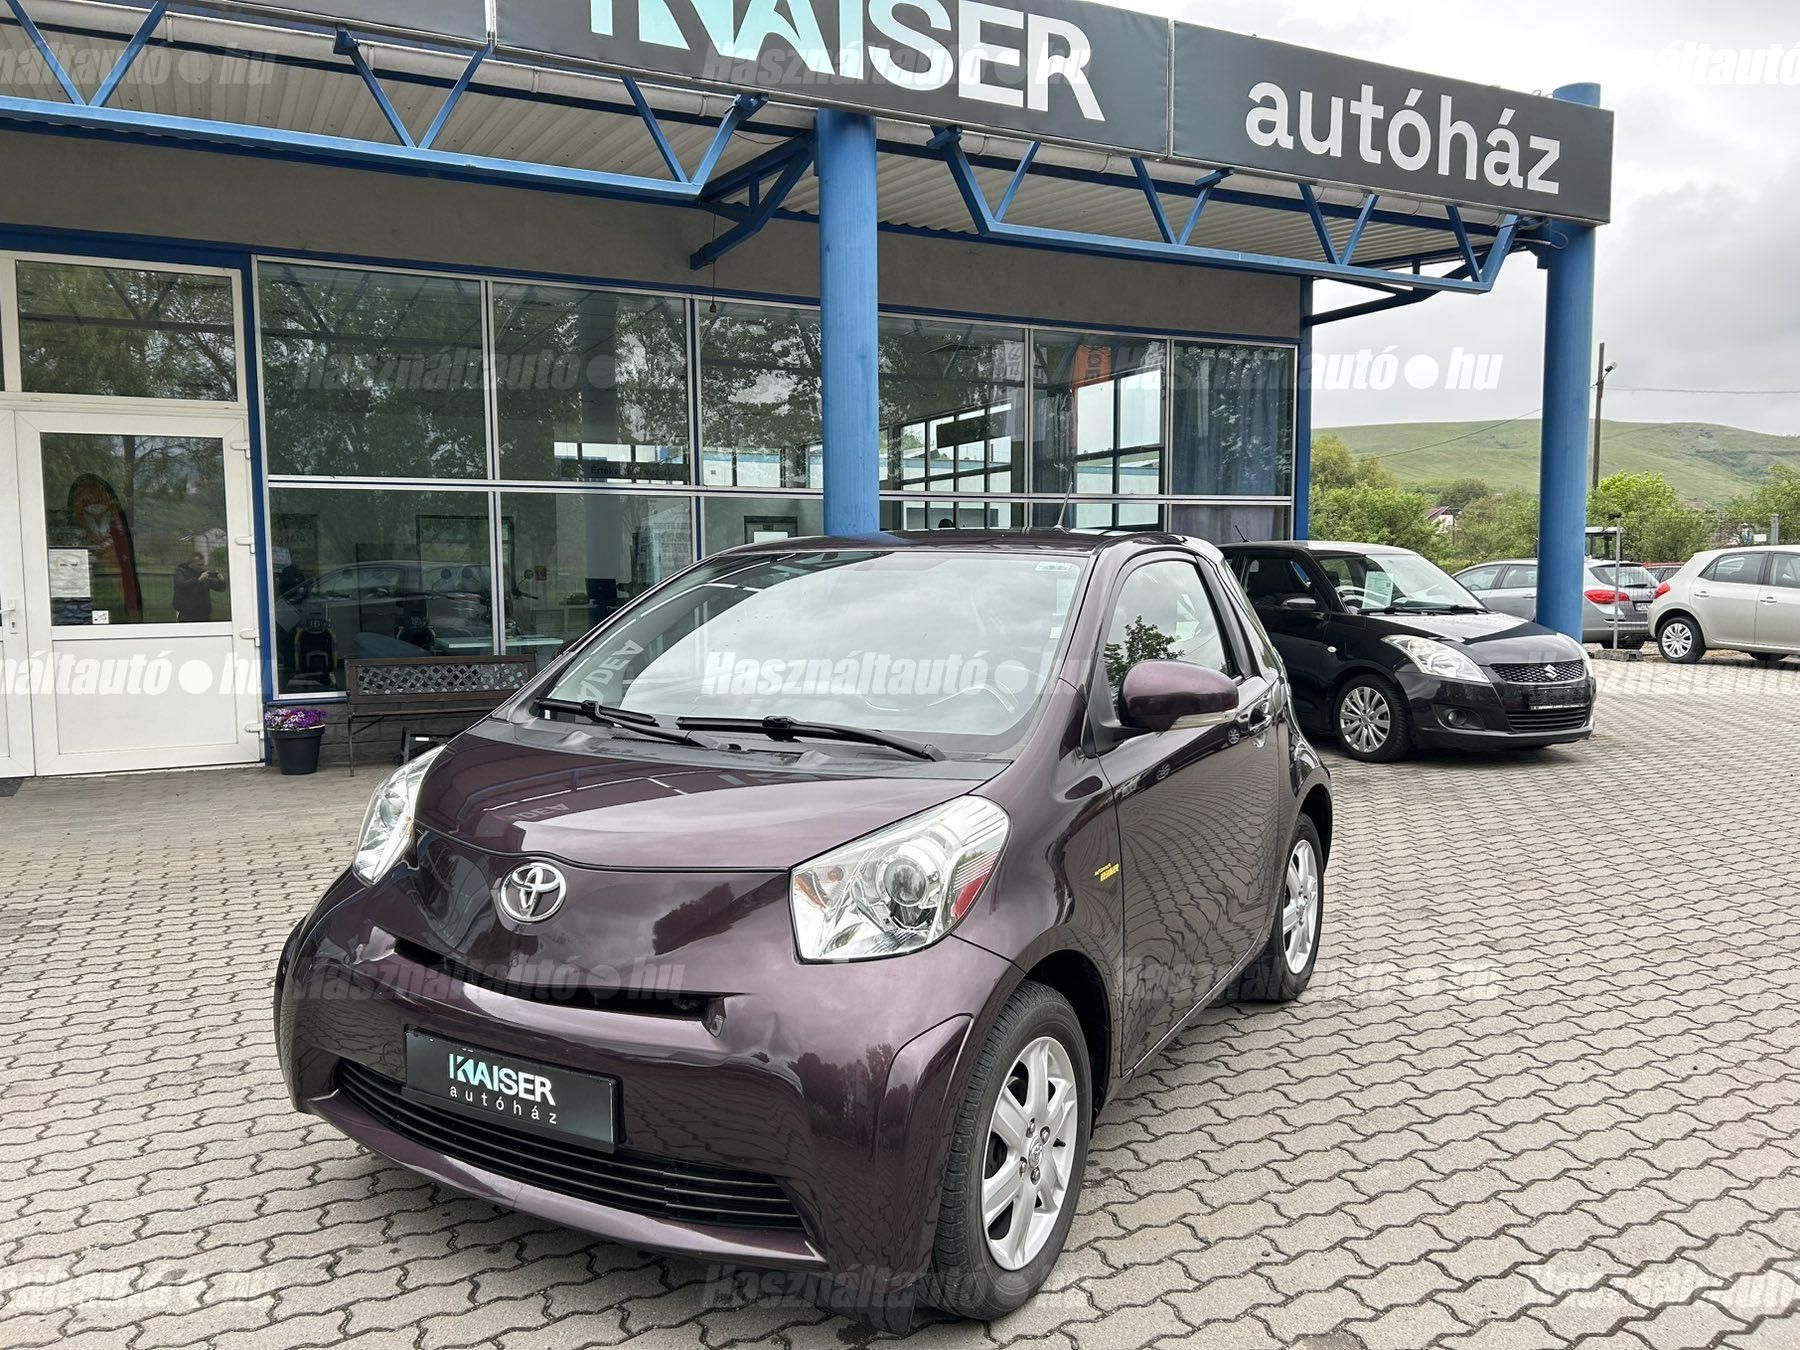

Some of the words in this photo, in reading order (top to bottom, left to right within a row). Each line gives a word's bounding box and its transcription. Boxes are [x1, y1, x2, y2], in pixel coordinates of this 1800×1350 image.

[1245, 82, 1561, 194] autóház
[449, 1053, 556, 1106] KAISER
[449, 1086, 557, 1125] autóház
